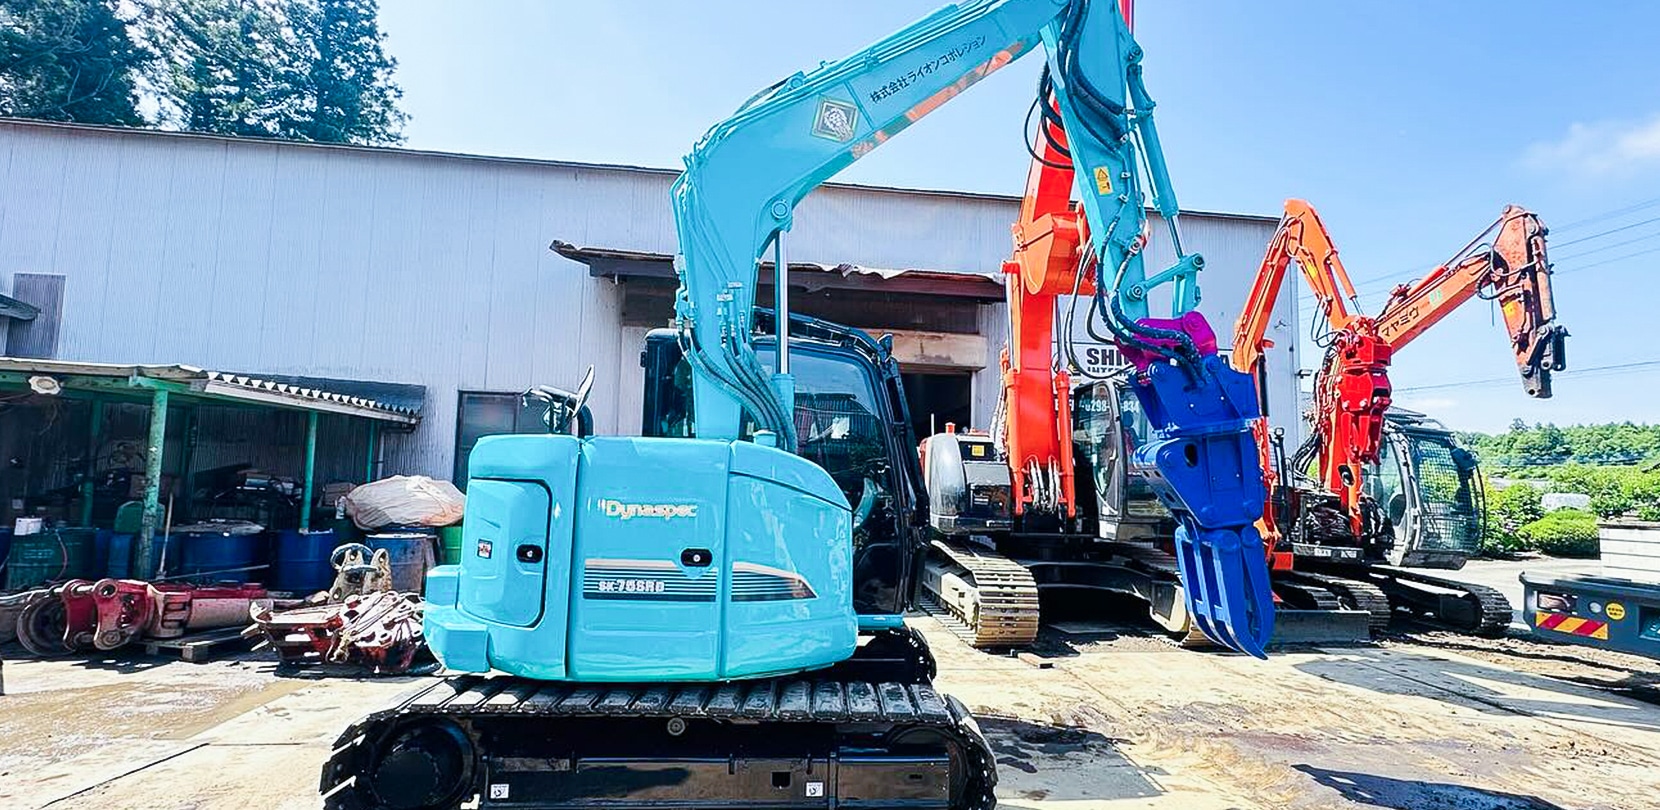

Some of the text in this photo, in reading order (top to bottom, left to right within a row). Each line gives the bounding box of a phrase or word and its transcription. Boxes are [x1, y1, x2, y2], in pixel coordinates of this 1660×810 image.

[870, 34, 986, 104] 株式会社ライオンコポレション
[605, 499, 698, 521] Dynaspec
